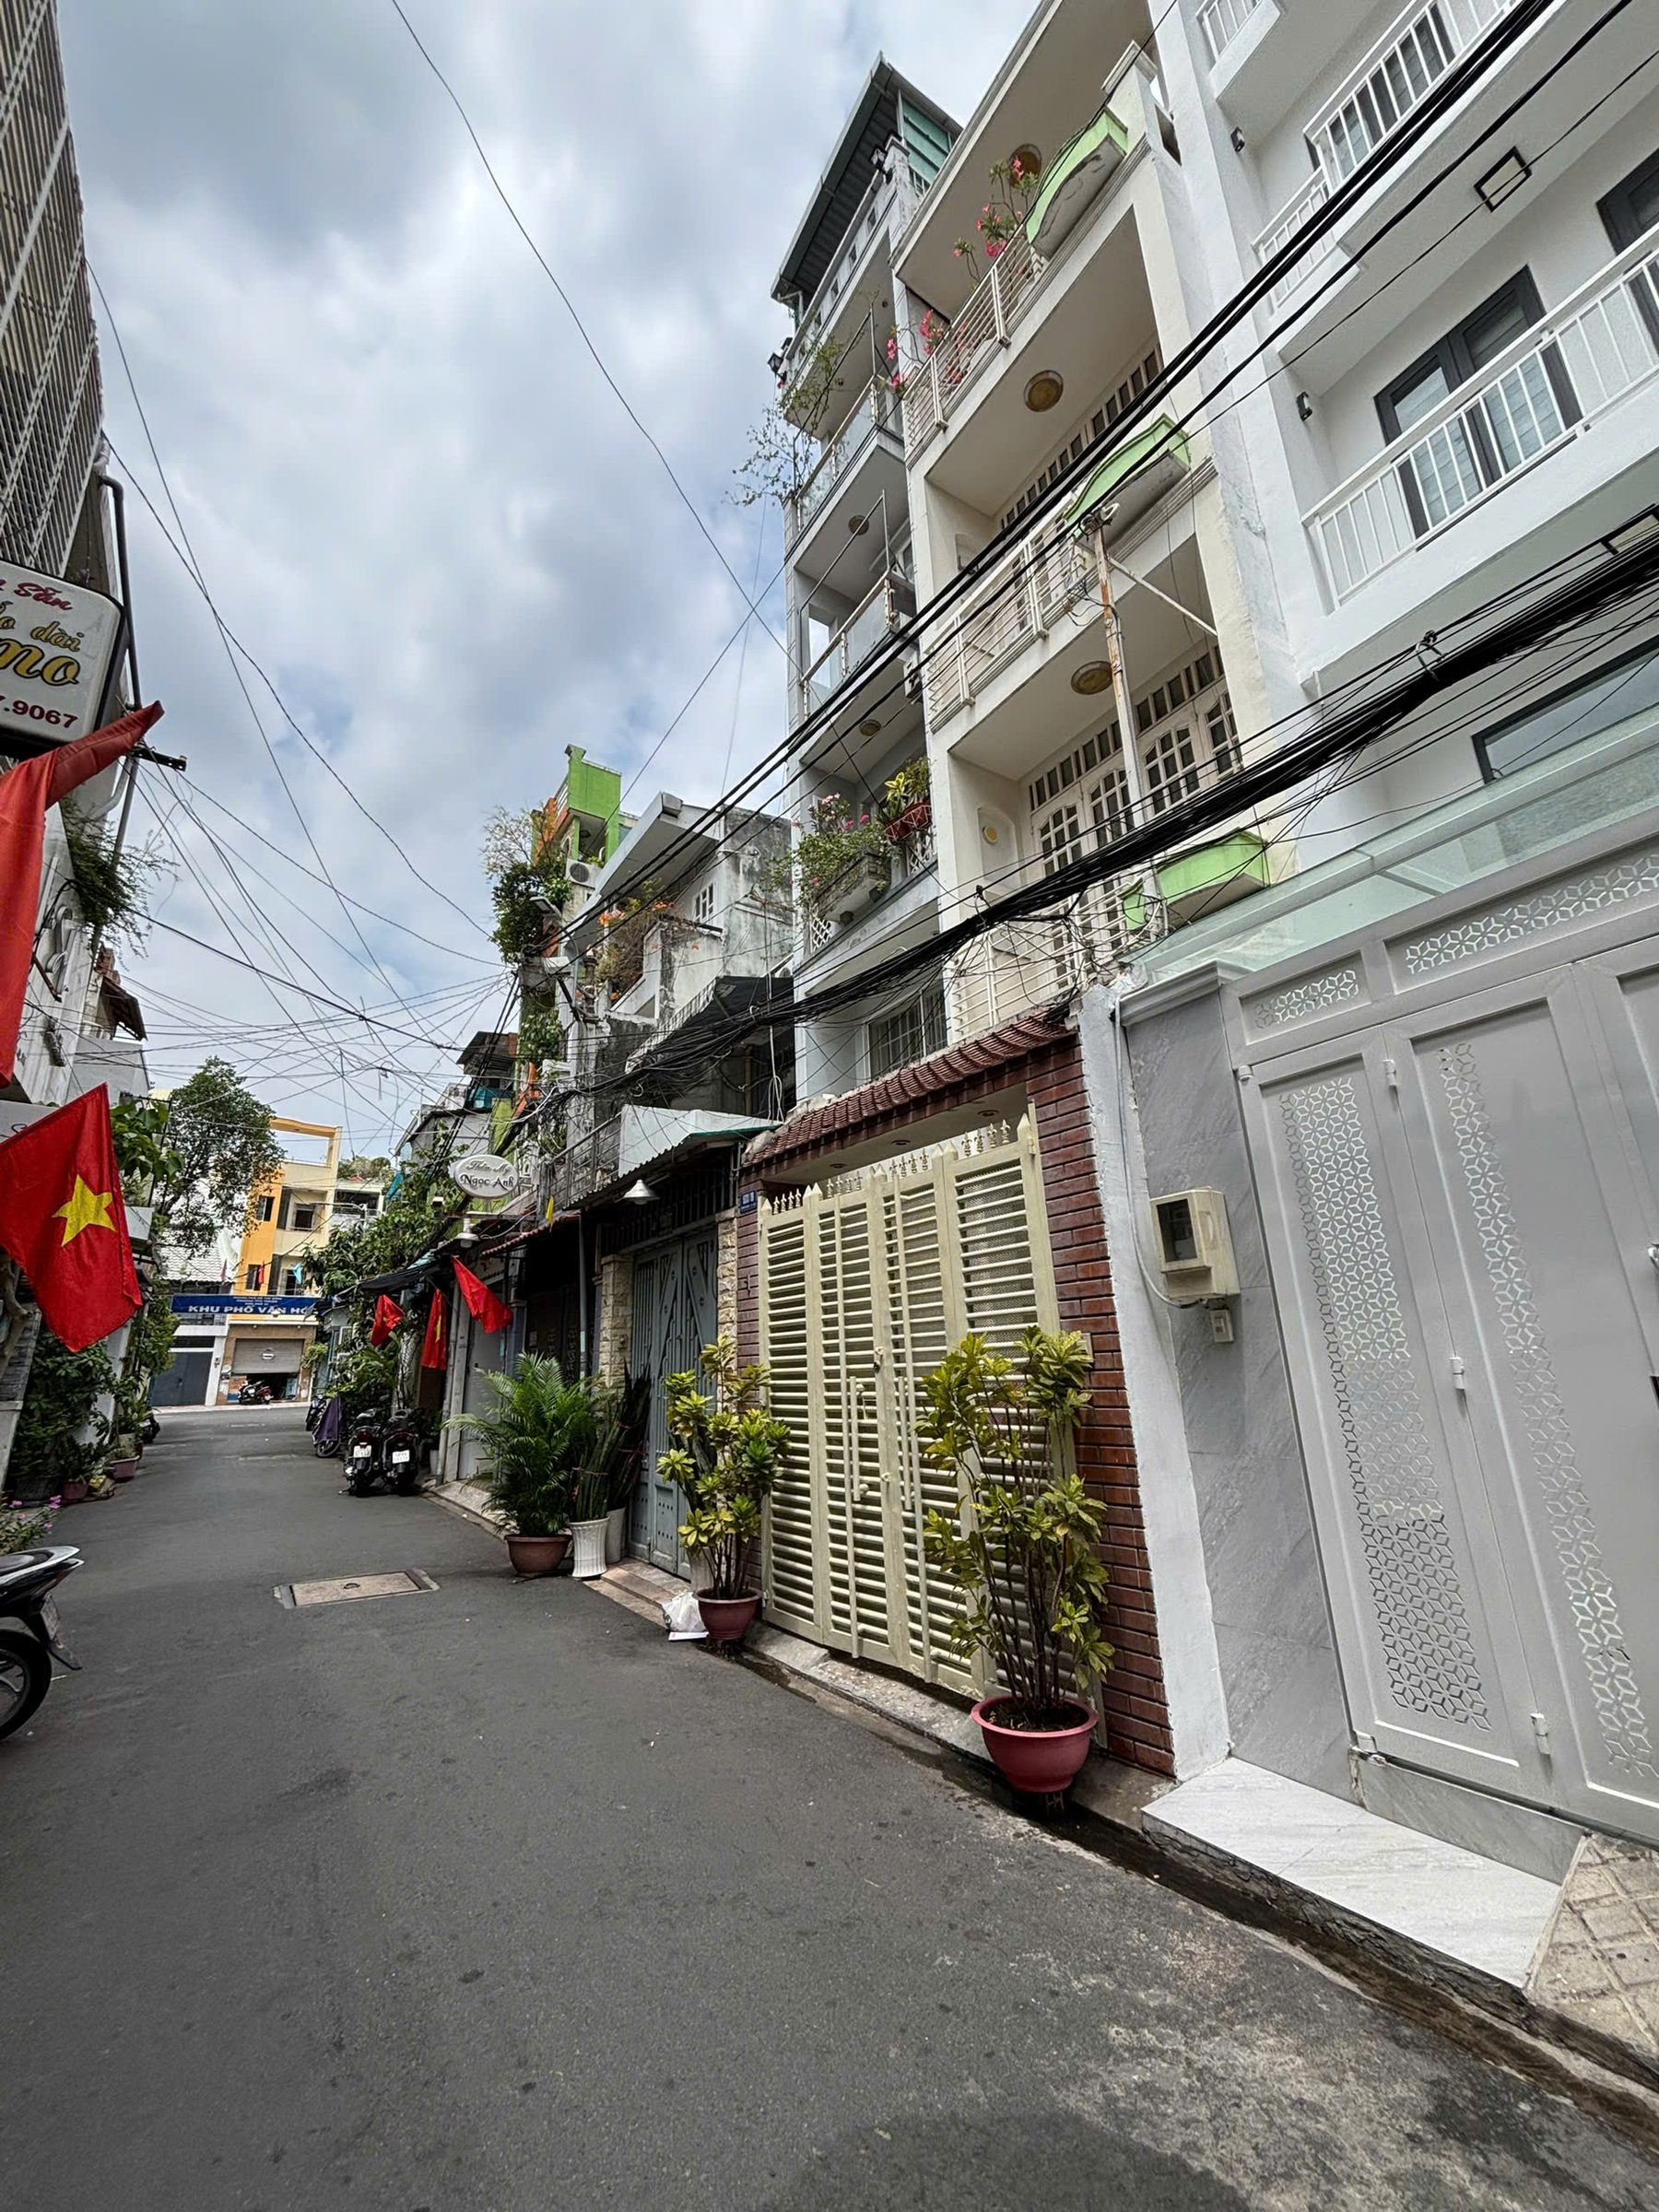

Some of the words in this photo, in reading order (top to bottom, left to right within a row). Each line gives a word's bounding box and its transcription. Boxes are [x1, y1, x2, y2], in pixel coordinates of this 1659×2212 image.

[29, 620, 84, 652] dài
[460, 1173, 490, 1189] Ngọc
[223, 1304, 254, 1313] PHỐ
[289, 1306, 319, 1315] HÓ
